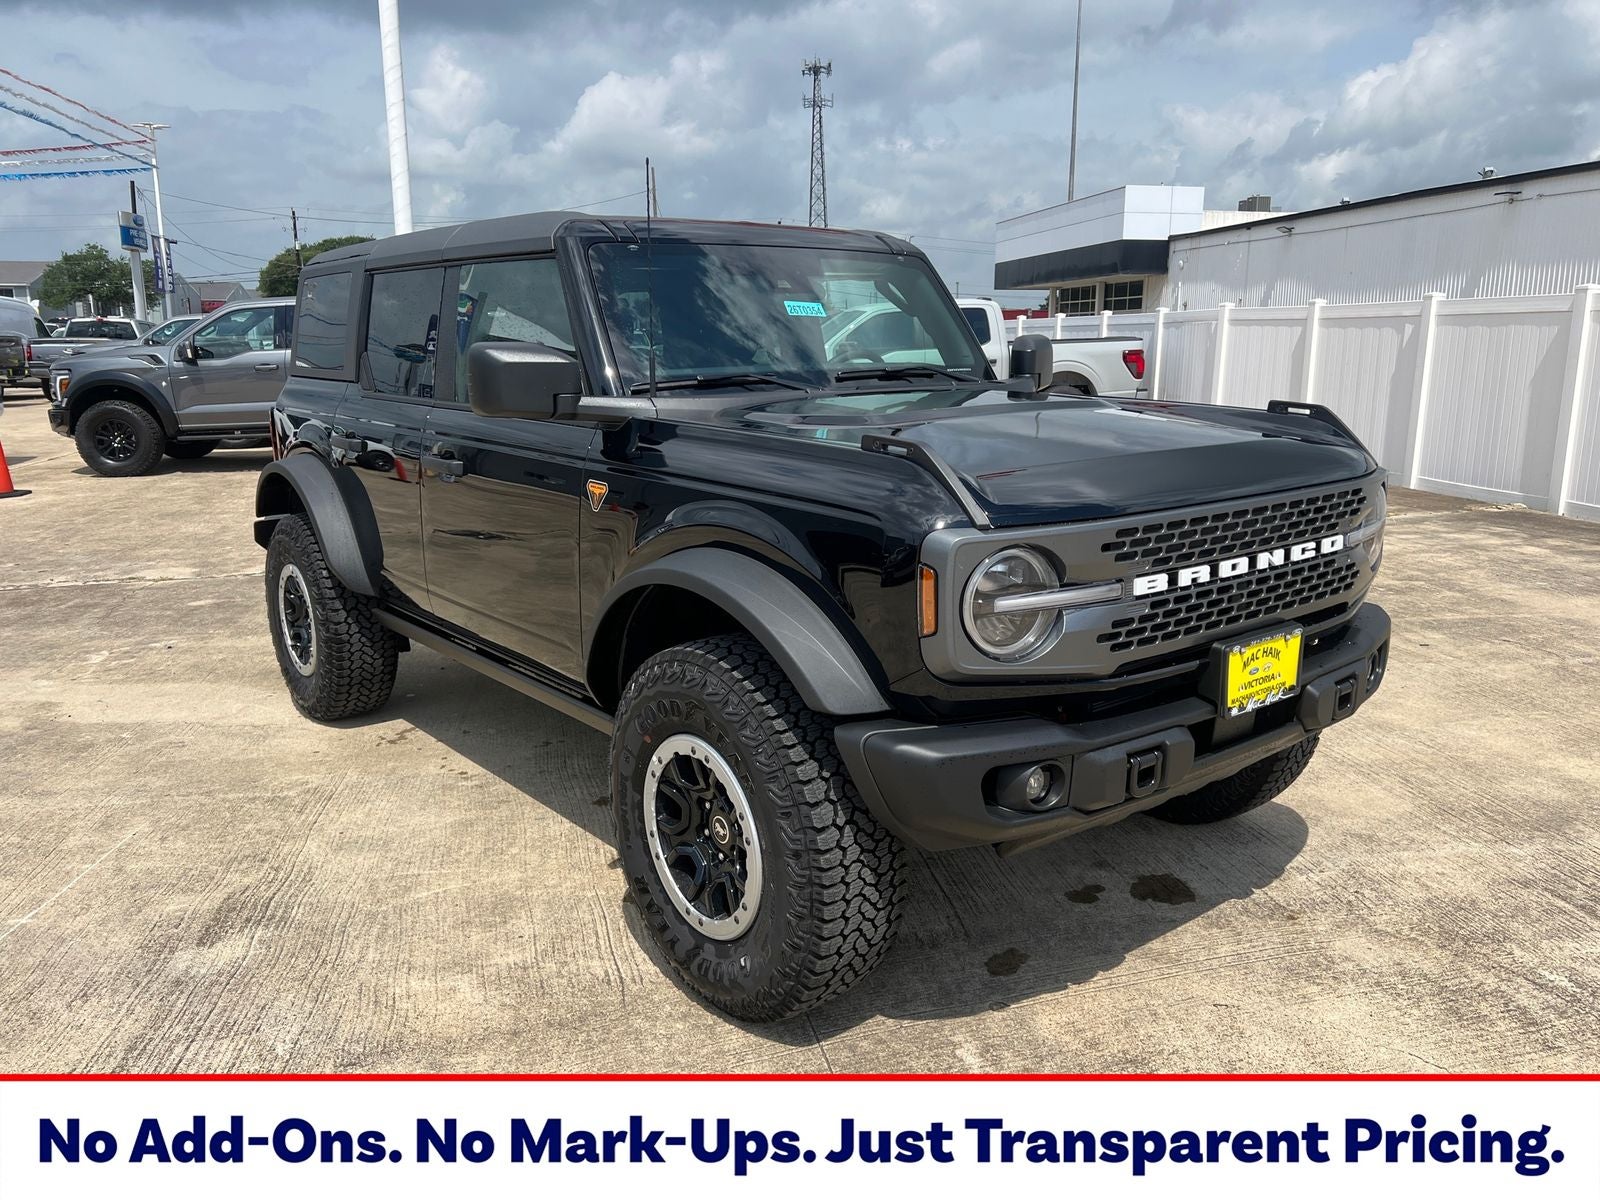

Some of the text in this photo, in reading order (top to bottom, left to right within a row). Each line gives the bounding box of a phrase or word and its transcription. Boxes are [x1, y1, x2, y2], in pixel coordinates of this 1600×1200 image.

[787, 304, 823, 315] 26T0354
[1132, 534, 1346, 597] BRONCO
[1241, 646, 1282, 672] MAC HAIK
[1243, 674, 1276, 690] VICTORIA
